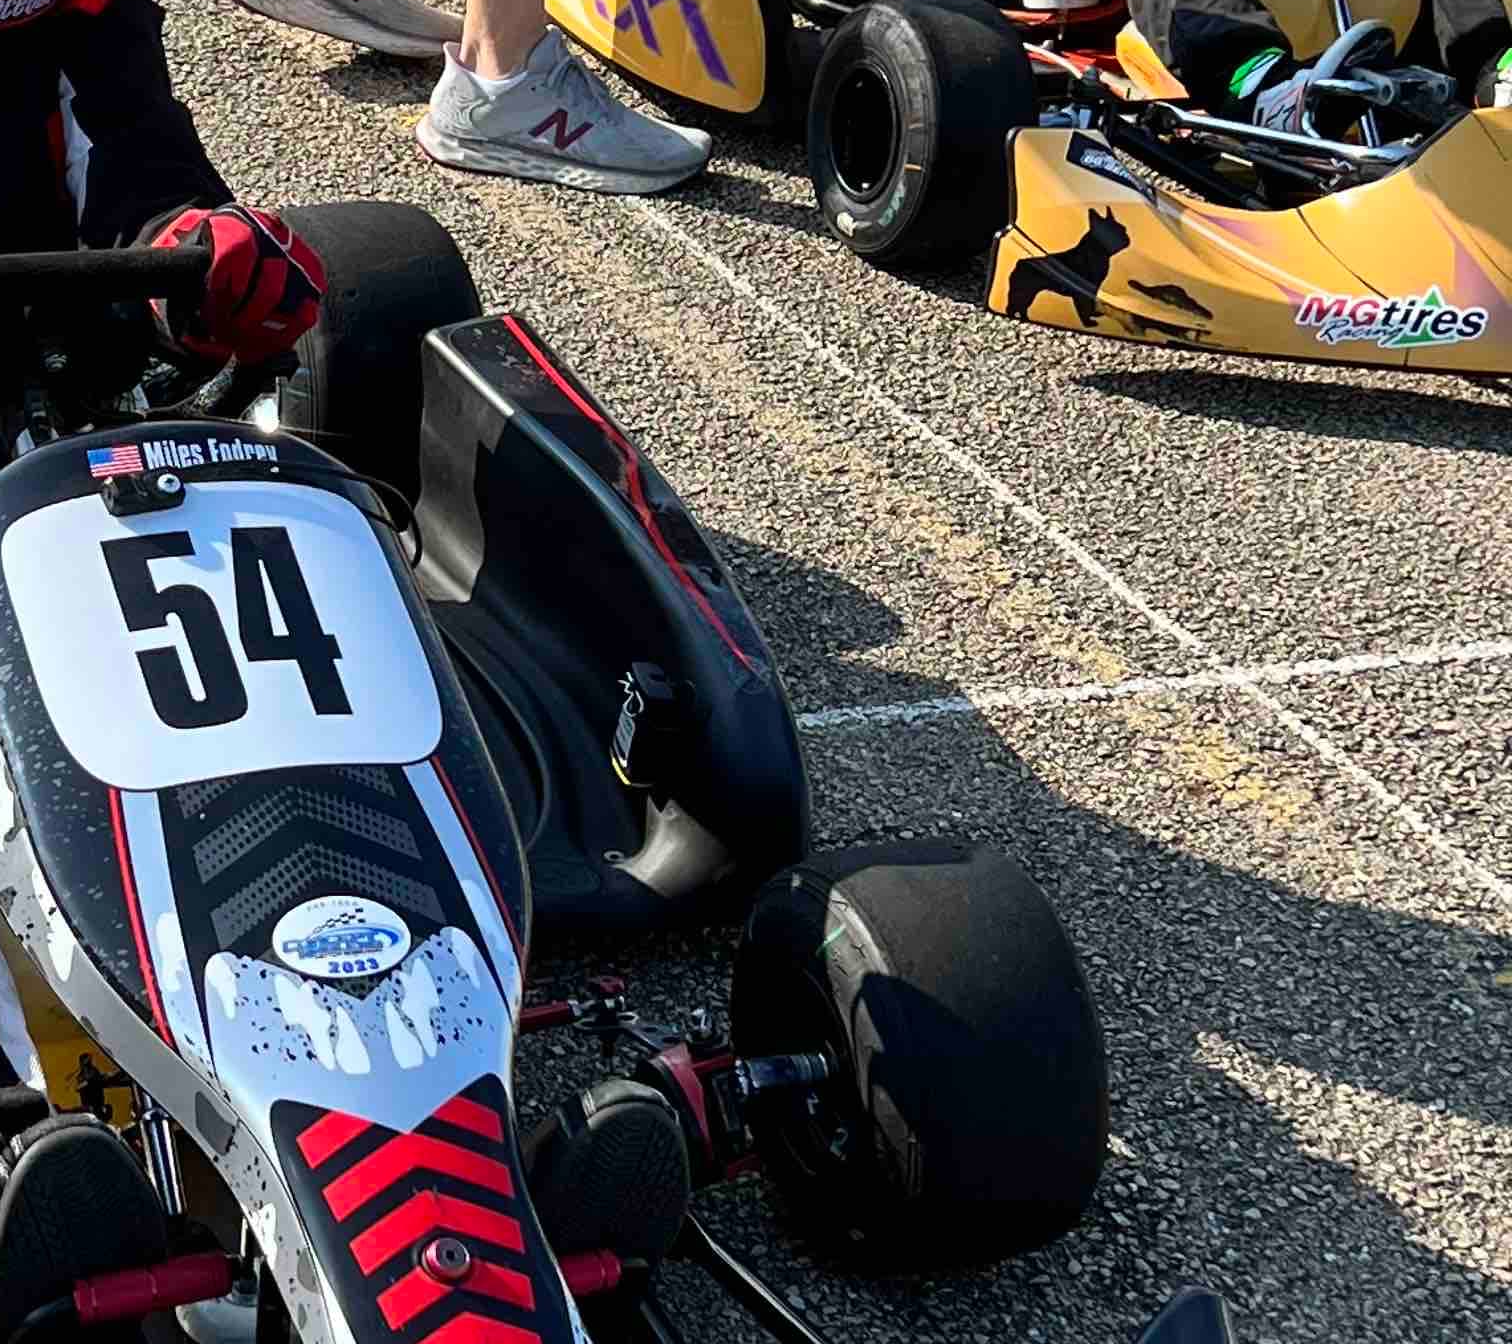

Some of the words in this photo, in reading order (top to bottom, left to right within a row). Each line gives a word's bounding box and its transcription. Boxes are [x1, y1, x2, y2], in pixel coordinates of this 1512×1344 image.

[143, 440, 204, 470] Miles
[100, 526, 353, 730] 54
[328, 958, 380, 974] 2023
